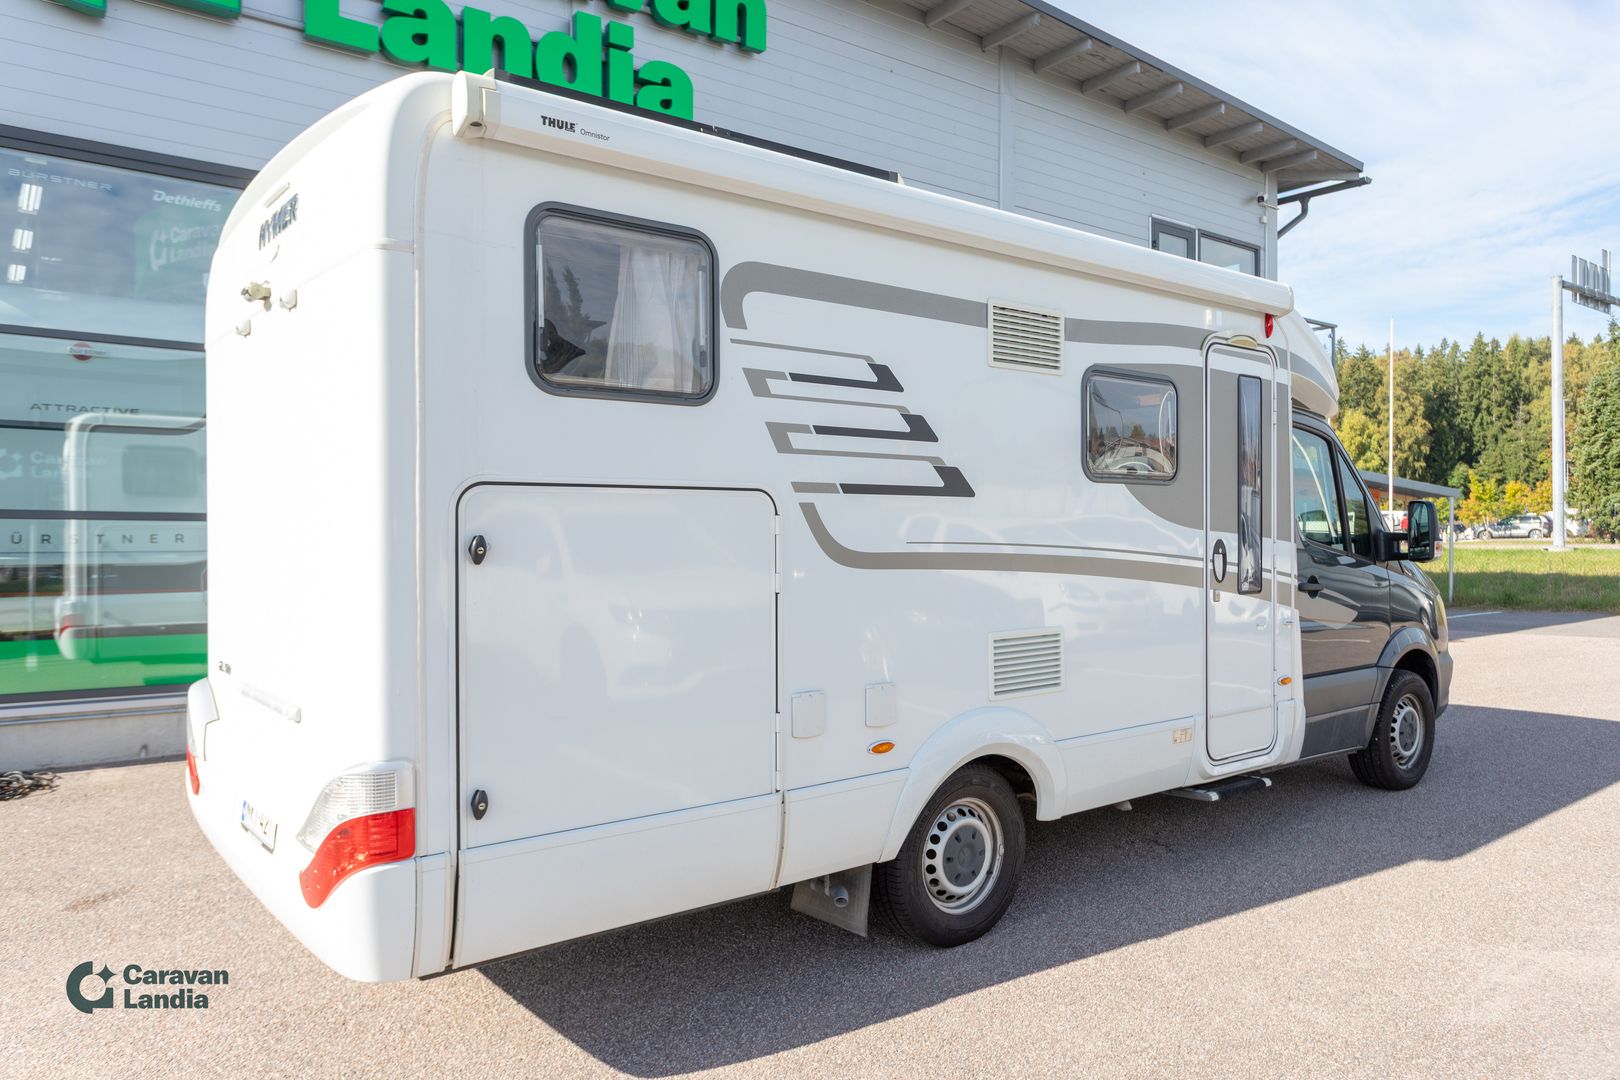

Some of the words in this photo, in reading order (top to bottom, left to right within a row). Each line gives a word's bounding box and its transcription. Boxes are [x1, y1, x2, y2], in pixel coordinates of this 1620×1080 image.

[304, 0, 694, 121] Landia
[541, 115, 576, 133] THULE
[580, 128, 610, 141] Omnistor
[152, 189, 222, 212] Dethleffs
[29, 403, 141, 415] ATTRACTIVE
